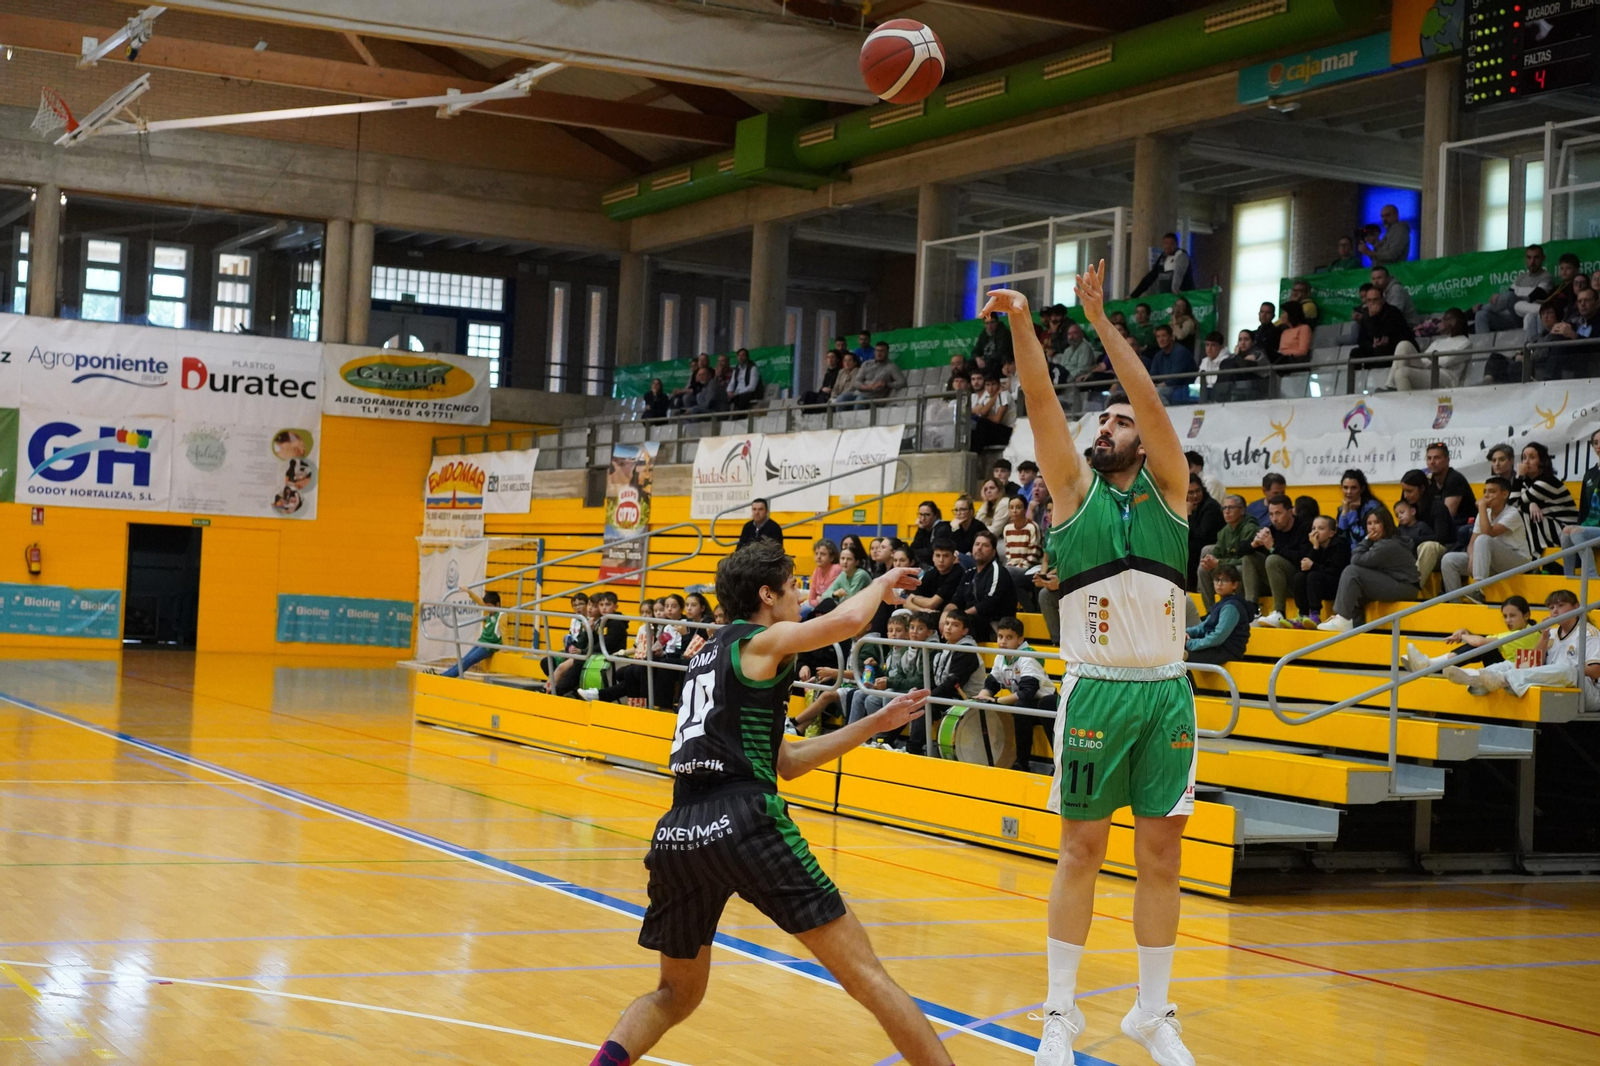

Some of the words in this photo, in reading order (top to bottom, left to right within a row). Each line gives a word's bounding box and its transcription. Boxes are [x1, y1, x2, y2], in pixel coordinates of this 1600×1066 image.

[1469, 13, 1478, 25] 10
[1526, 2, 1561, 20] JUGADOR
[1469, 29, 1477, 40] 11
[1467, 45, 1476, 57] 12
[1524, 50, 1552, 67] FALTAS
[1286, 50, 1358, 83] cajamar
[1466, 61, 1476, 73] 13
[1465, 77, 1474, 89] 14
[1535, 69, 1546, 89] 4
[1464, 92, 1474, 104] 15
[1427, 275, 1484, 294] INAGROUP
[28, 345, 168, 374] Agroponiente
[232, 360, 275, 370] PLÁSTICO
[141, 374, 164, 382] GRUPO
[181, 356, 316, 399] Duratec
[335, 395, 429, 409] ASESORAMIENTO
[432, 402, 480, 413] TECNICO
[389, 408, 411, 417] 950
[416, 410, 454, 419] 497711
[28, 422, 152, 486] GH
[1223, 436, 1291, 470] sabores
[1411, 450, 1421, 462] DE
[28, 485, 67, 495] GODOY
[70, 488, 136, 501] HORTALIZAS,
[139, 493, 156, 502] S.L.
[618, 506, 638, 522] OTTO
[24, 597, 61, 608] Bioline
[80, 601, 116, 611] Bioline
[1088, 595, 1097, 607] EL
[296, 606, 330, 616] Bioline
[347, 609, 379, 619] Bioline
[1088, 611, 1097, 644] EJIDO
[1068, 737, 1077, 746] EL
[1079, 739, 1103, 750] EJIDO
[1068, 760, 1095, 796] 11
[657, 815, 730, 842] OKEYMAS
[655, 842, 700, 850] FITNESS
[703, 827, 733, 846] CLUB
